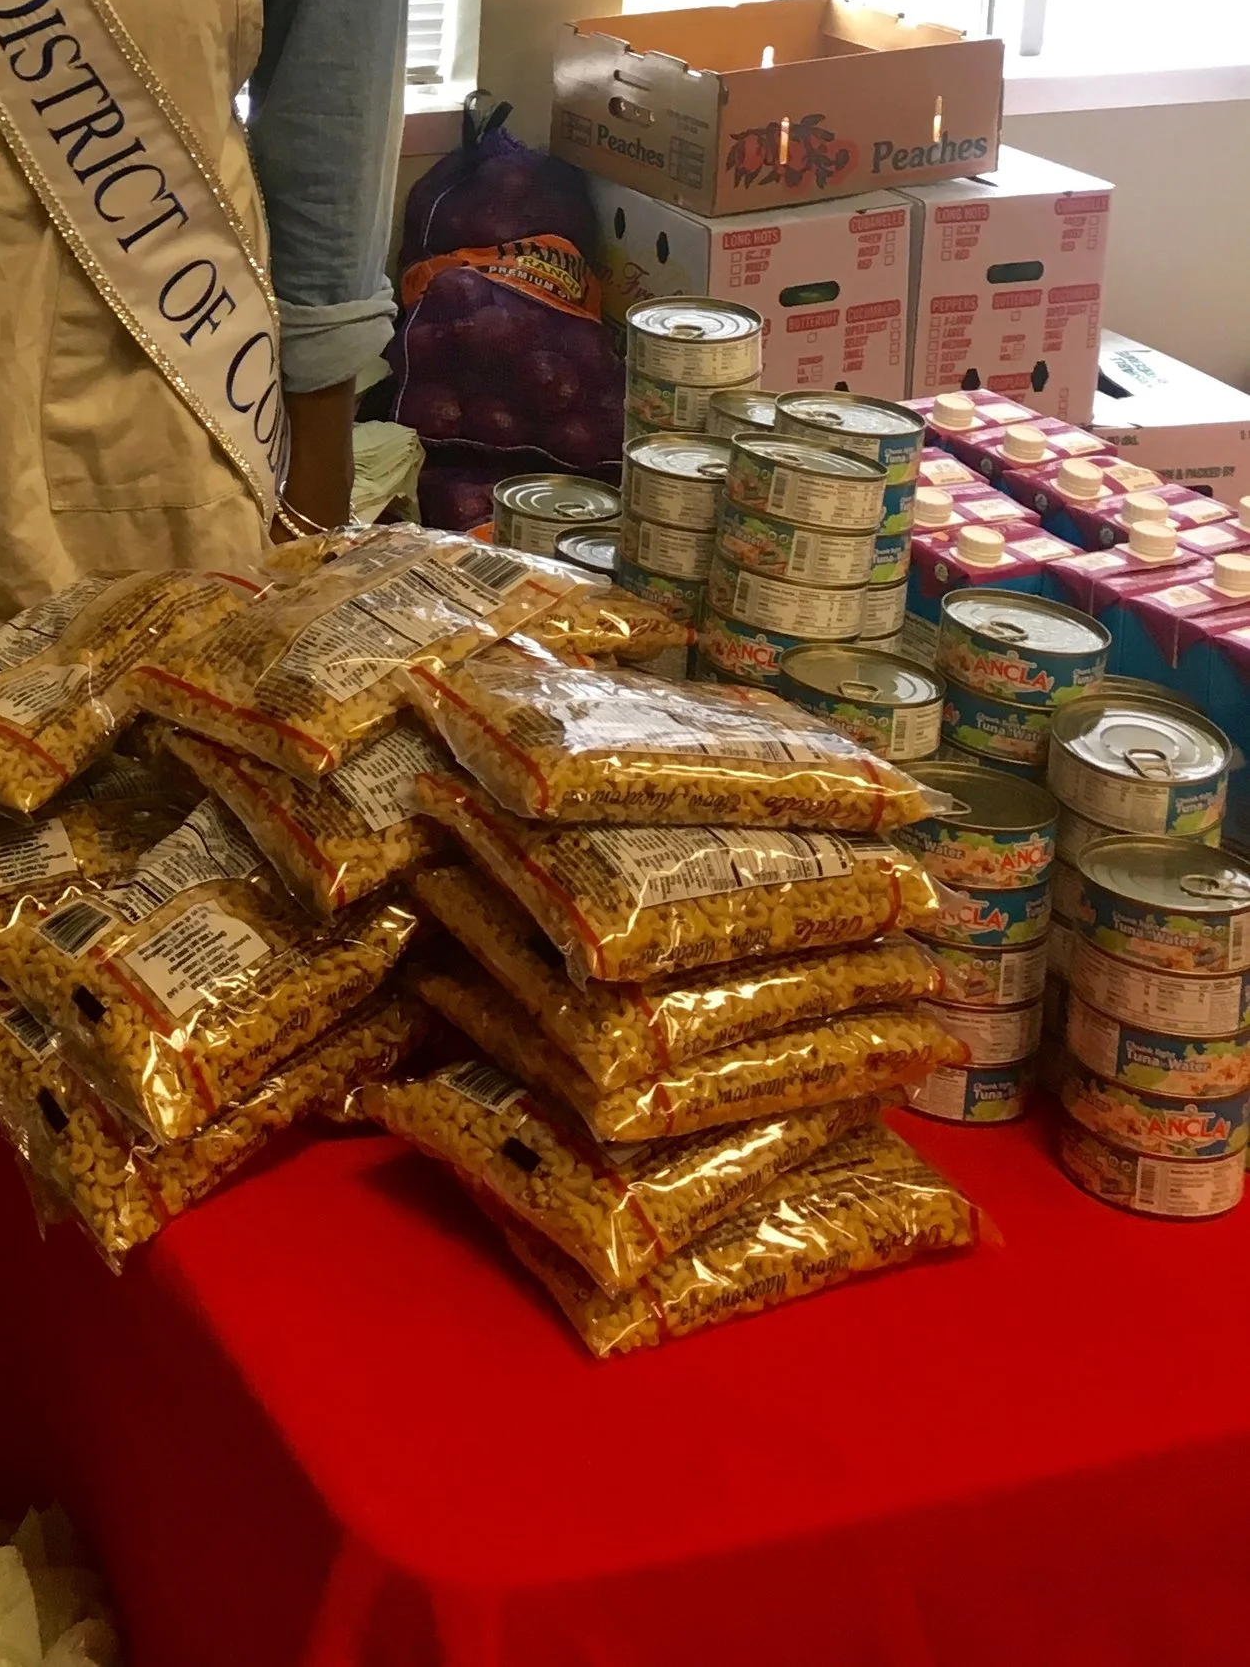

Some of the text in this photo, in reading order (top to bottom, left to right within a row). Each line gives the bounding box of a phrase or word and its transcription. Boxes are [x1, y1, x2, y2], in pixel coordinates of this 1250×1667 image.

[597, 123, 666, 169] Peaches
[871, 133, 988, 175] Peaches
[936, 207, 962, 223] LONG
[724, 228, 780, 248] LONG HOTS
[489, 265, 554, 292] PREMIUM
[522, 256, 581, 294] RANCH
[159, 257, 237, 347] OF
[427, 557, 471, 589] Nutrition
[726, 642, 780, 668] ANCL
[973, 658, 1049, 691] ANCLA
[1000, 846, 1051, 870] ANCL
[1153, 928, 1200, 947] Water
[1126, 1049, 1212, 1073] Tuna Water
[1149, 1117, 1227, 1139] ANCLA
